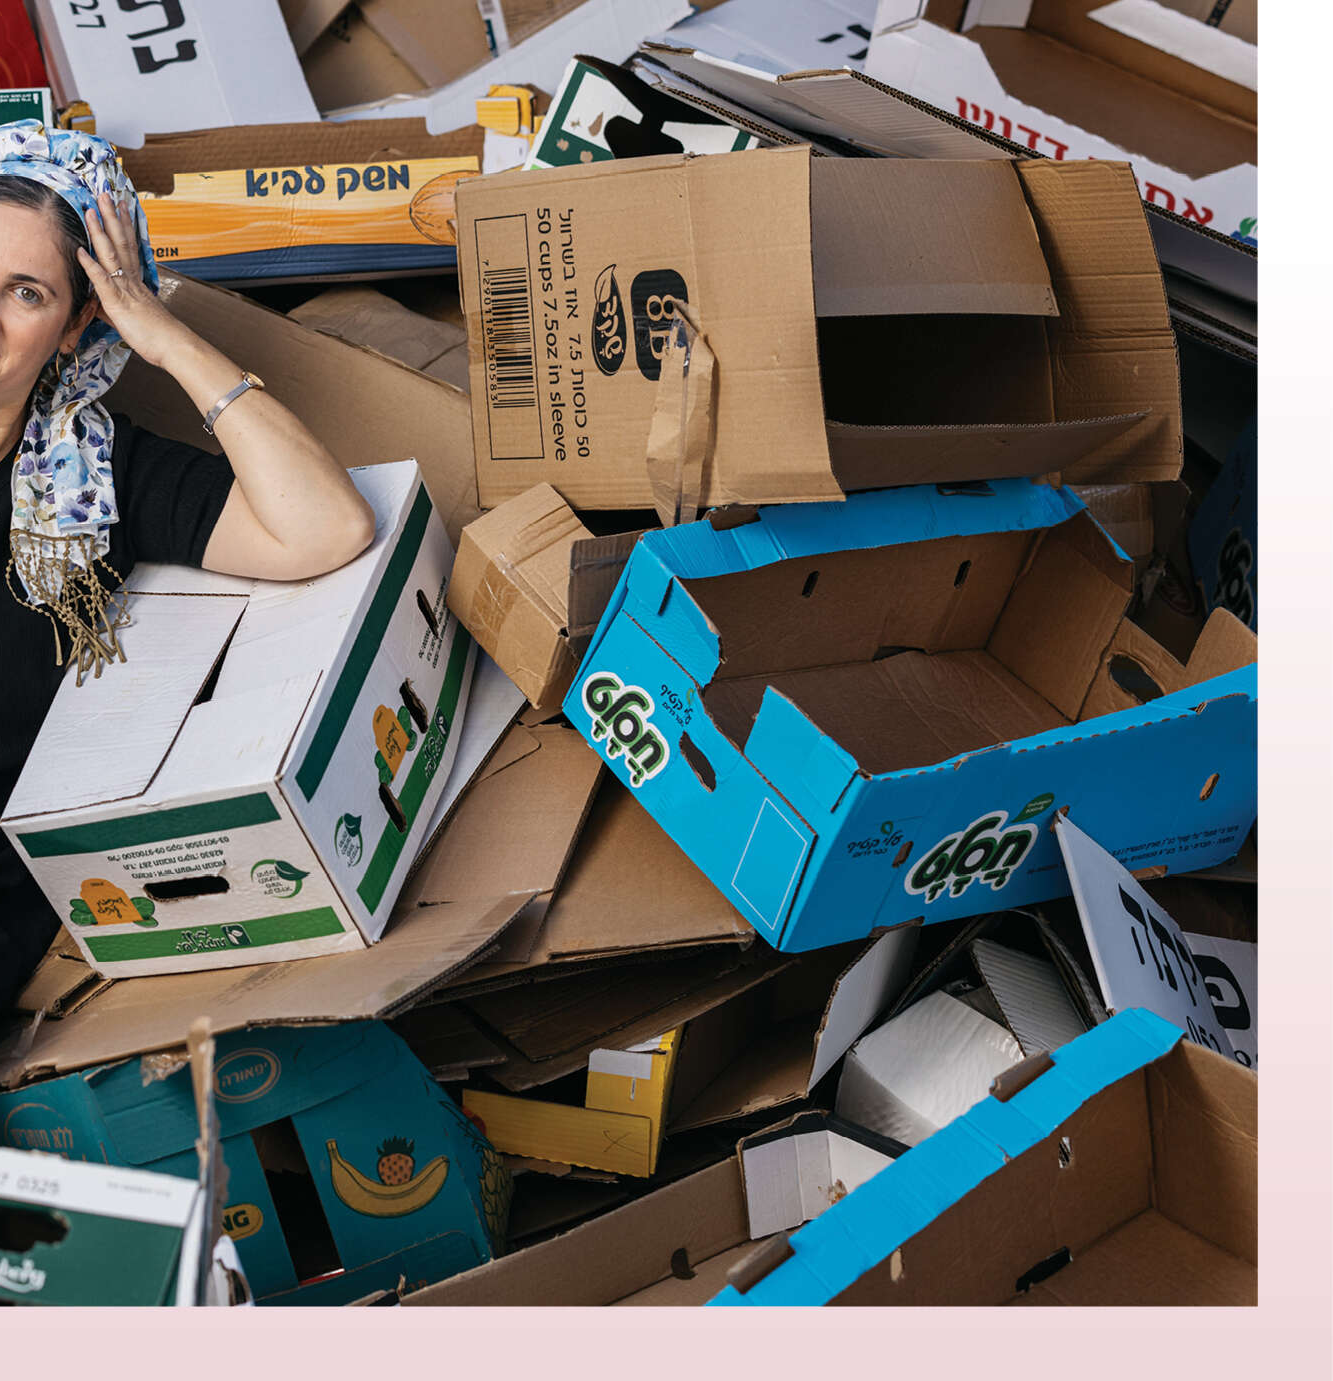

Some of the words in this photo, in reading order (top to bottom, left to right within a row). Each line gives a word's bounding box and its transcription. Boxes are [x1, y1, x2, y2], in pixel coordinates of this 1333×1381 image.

[337, 163, 410, 201] משק
[536, 207, 552, 235] 50
[558, 208, 577, 281] בשרוול
[537, 241, 554, 293] cups
[566, 287, 579, 320] אוז
[543, 297, 560, 360] 7.5oz
[568, 333, 582, 361] 7.5
[549, 365, 564, 386] in
[570, 368, 588, 429] כוסות
[550, 393, 567, 462] sleeve
[576, 436, 590, 458] 50
